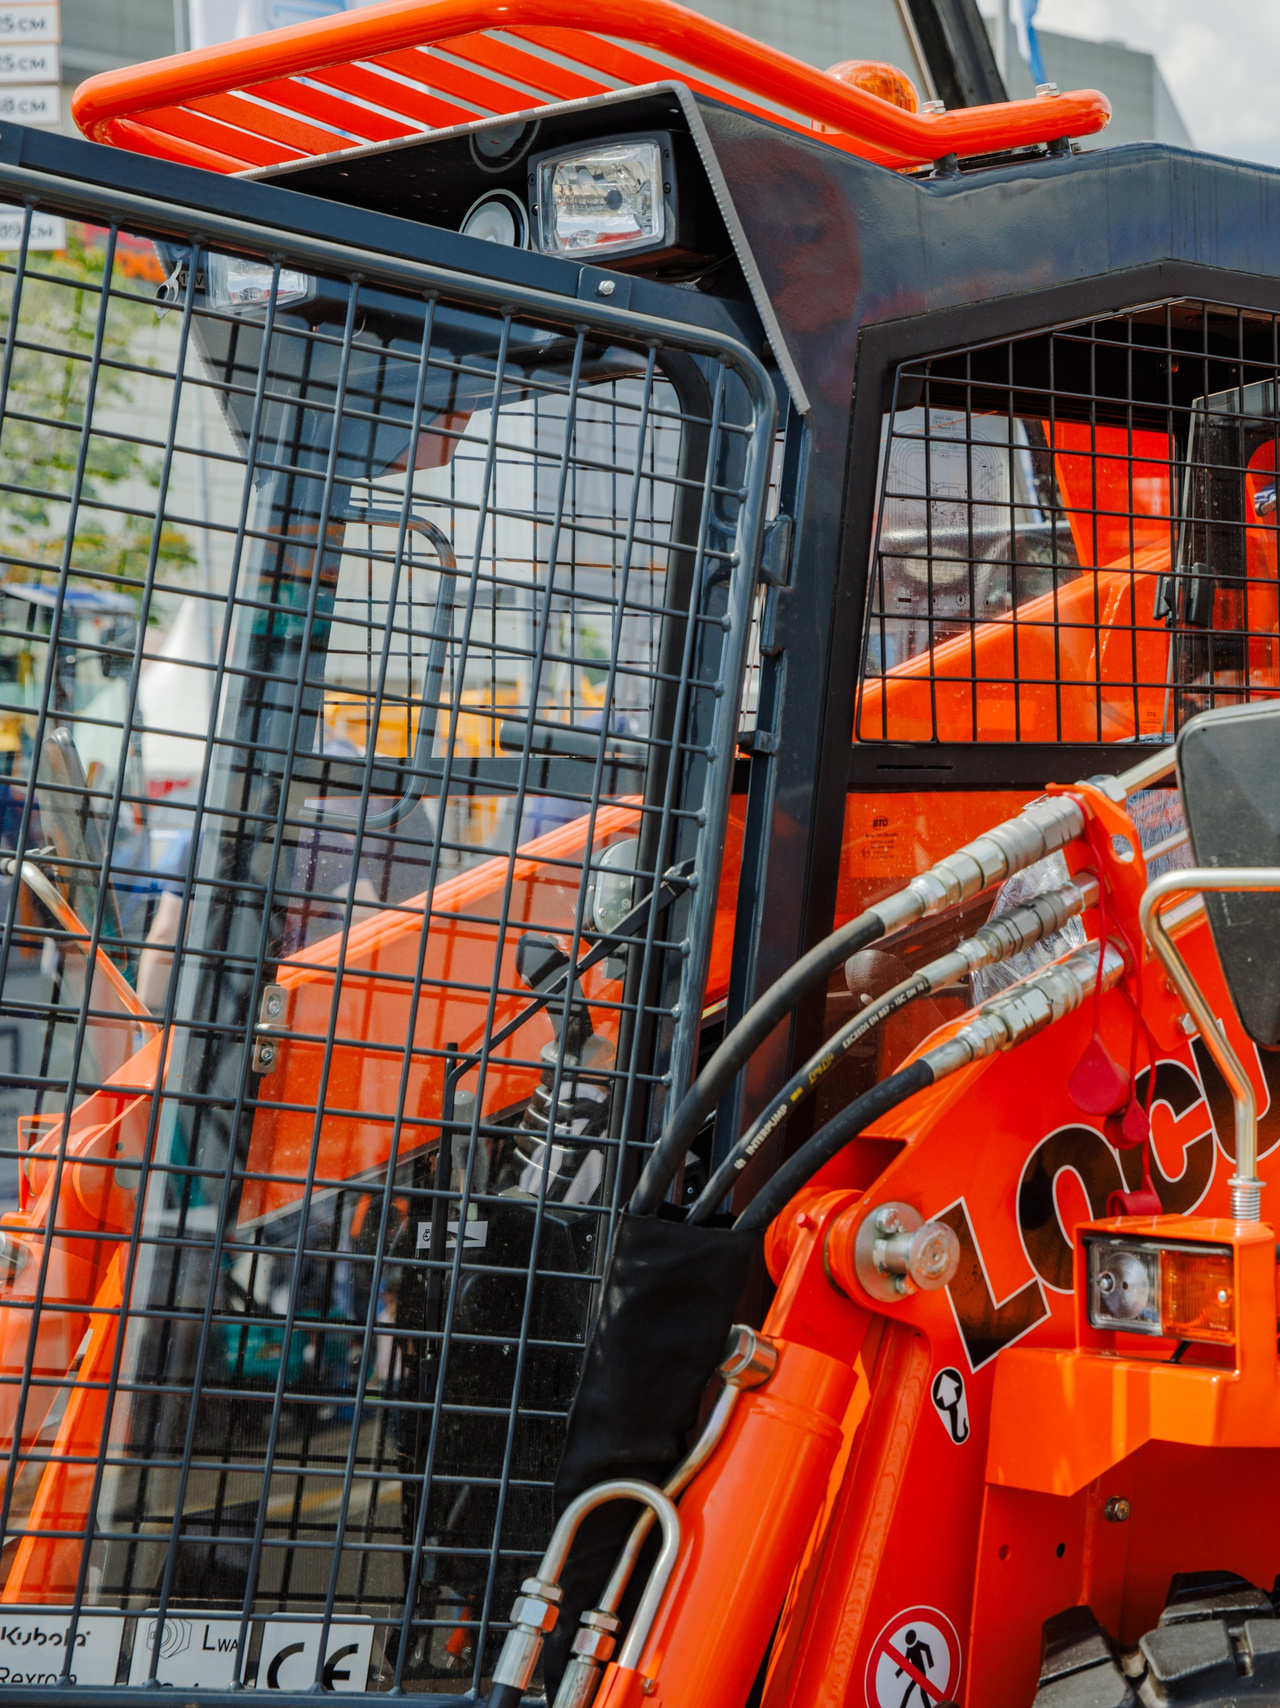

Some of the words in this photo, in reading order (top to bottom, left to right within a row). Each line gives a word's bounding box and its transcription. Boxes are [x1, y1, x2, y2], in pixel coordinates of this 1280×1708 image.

[0, 14, 14, 33] 5
[0, 53, 14, 72] 5
[180, 272, 204, 286] 1V
[745, 1103, 788, 1156] INTERPUMP
[0, 1667, 77, 1684] Rexro
[267, 1642, 359, 1690] CE
